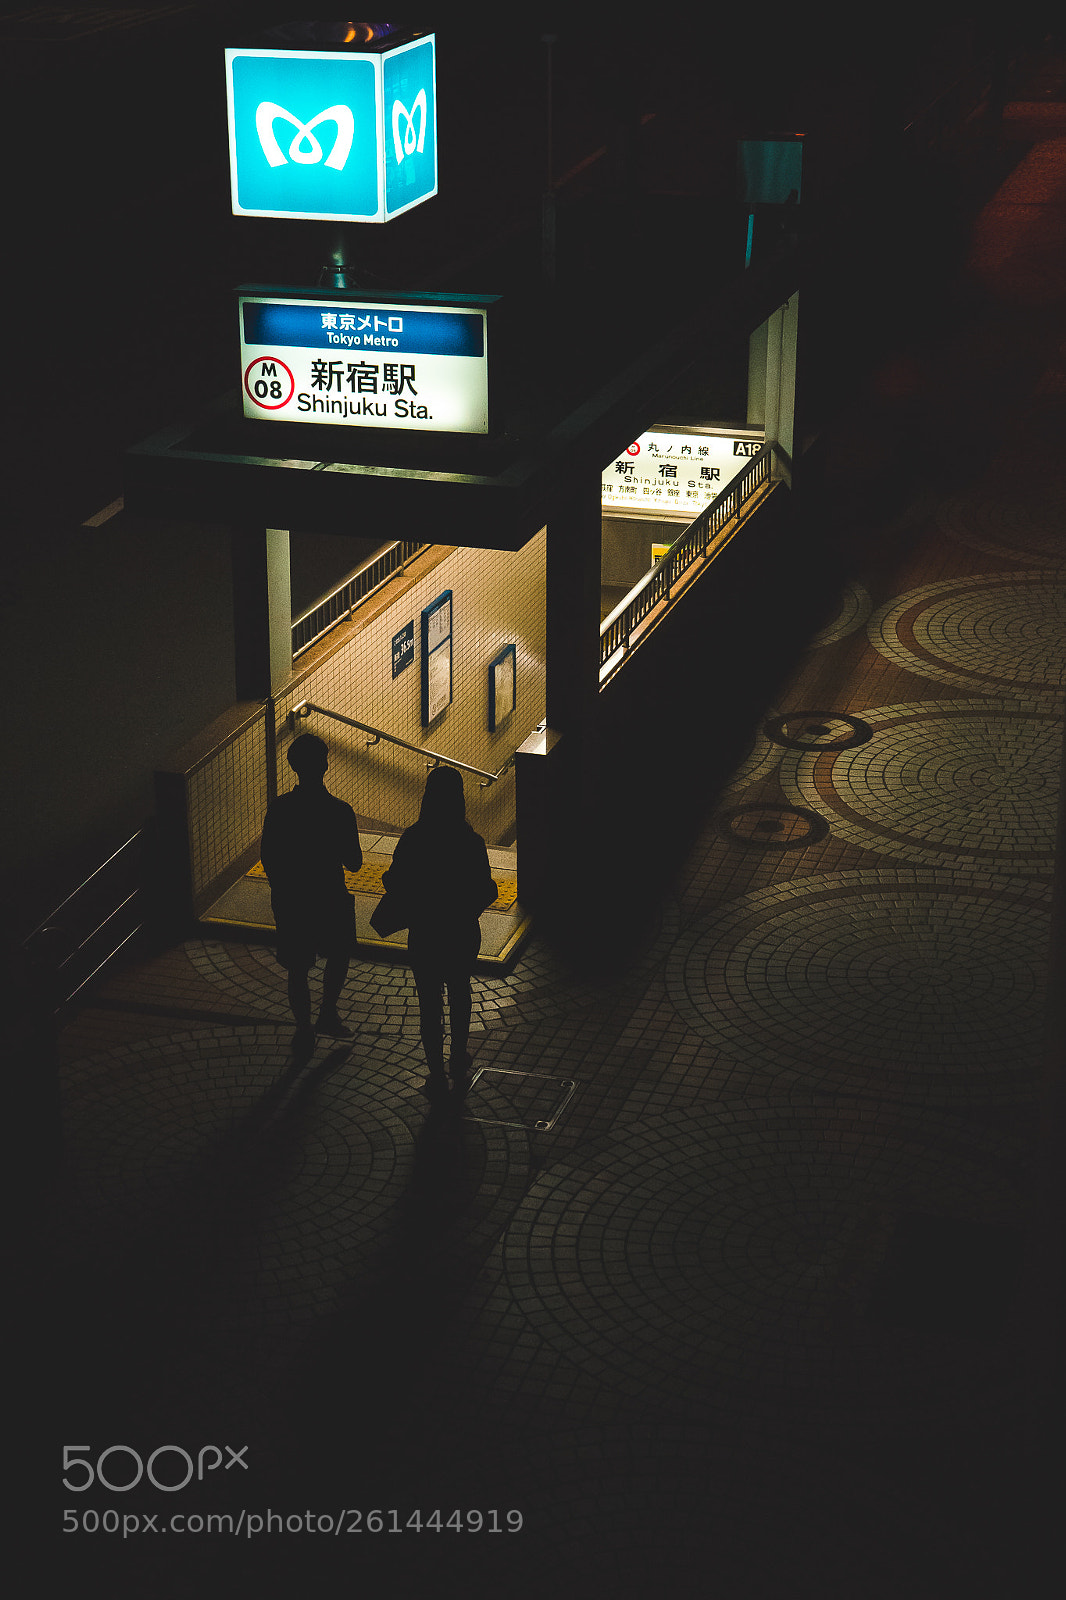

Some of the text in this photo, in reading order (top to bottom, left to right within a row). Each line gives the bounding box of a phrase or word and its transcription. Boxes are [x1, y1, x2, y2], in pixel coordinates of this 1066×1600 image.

[320, 312, 404, 333] 東京メトロ
[326, 332, 399, 347] Tokyo Metro
[261, 362, 277, 377] M
[311, 358, 418, 396] 新宿駅
[254, 380, 283, 399] 08
[297, 393, 434, 420] Shinjuku Sta.
[647, 442, 710, 457] 丸ノ内線
[615, 460, 721, 482] 新宿駅
[624, 475, 680, 487] Shinjuku
